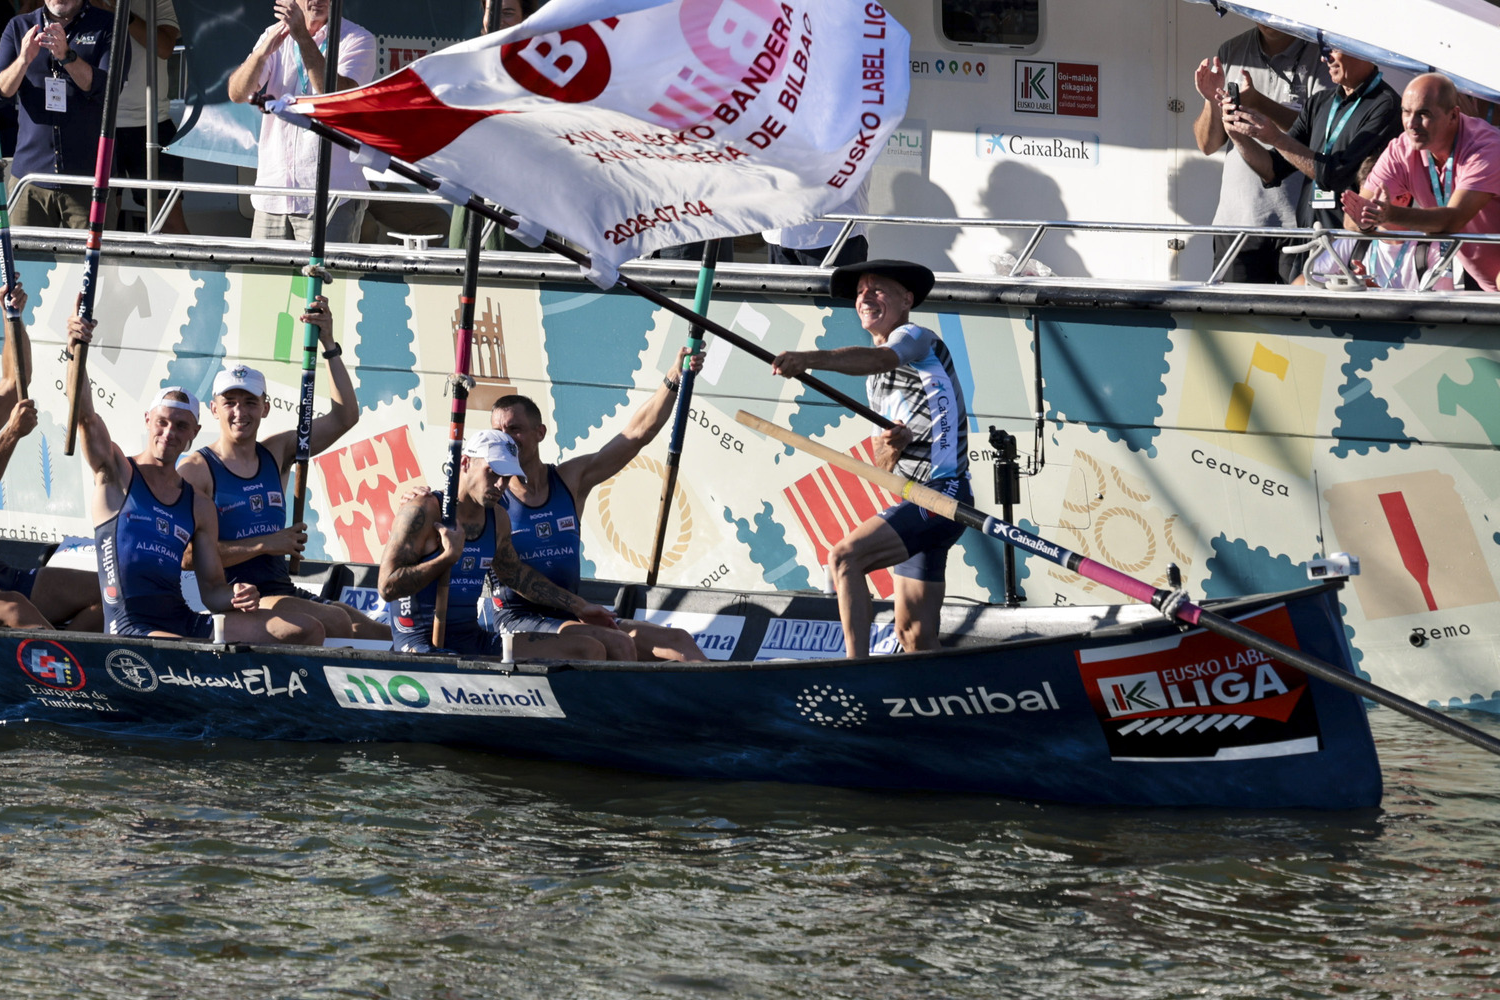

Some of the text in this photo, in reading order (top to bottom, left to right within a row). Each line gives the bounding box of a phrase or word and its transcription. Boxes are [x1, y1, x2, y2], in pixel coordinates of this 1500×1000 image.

[713, 2, 794, 124] BANDERA
[1057, 72, 1097, 85] Goi-mailako
[1061, 82, 1094, 93] elikagaiak
[827, 112, 881, 189] EUSKO
[862, 48, 885, 105] LABEL
[1017, 101, 1053, 111] EUSKO LABEL
[746, 116, 787, 150] DE
[1009, 134, 1089, 160] CaixaBank
[604, 200, 714, 245] 2026-07-04
[300, 381, 314, 434] CaixaBank
[937, 395, 950, 451] CaixaBank
[688, 407, 744, 454] aboga
[1191, 449, 1290, 498] Ceavoga
[236, 523, 281, 539] ALAKRANA
[1007, 529, 1060, 559] CaixaBank
[102, 536, 116, 585] satlink
[136, 541, 179, 562] ALAKRANA
[520, 546, 575, 560] ALAKRANA
[1413, 621, 1471, 642] Remo
[1162, 649, 1276, 684] EUSKO LABE
[26, 684, 108, 700] Europea de
[441, 686, 546, 707] Marinoil
[882, 681, 1060, 719] zunibal
[1167, 663, 1289, 708] LIGA
[37, 696, 92, 710] Tunidos
